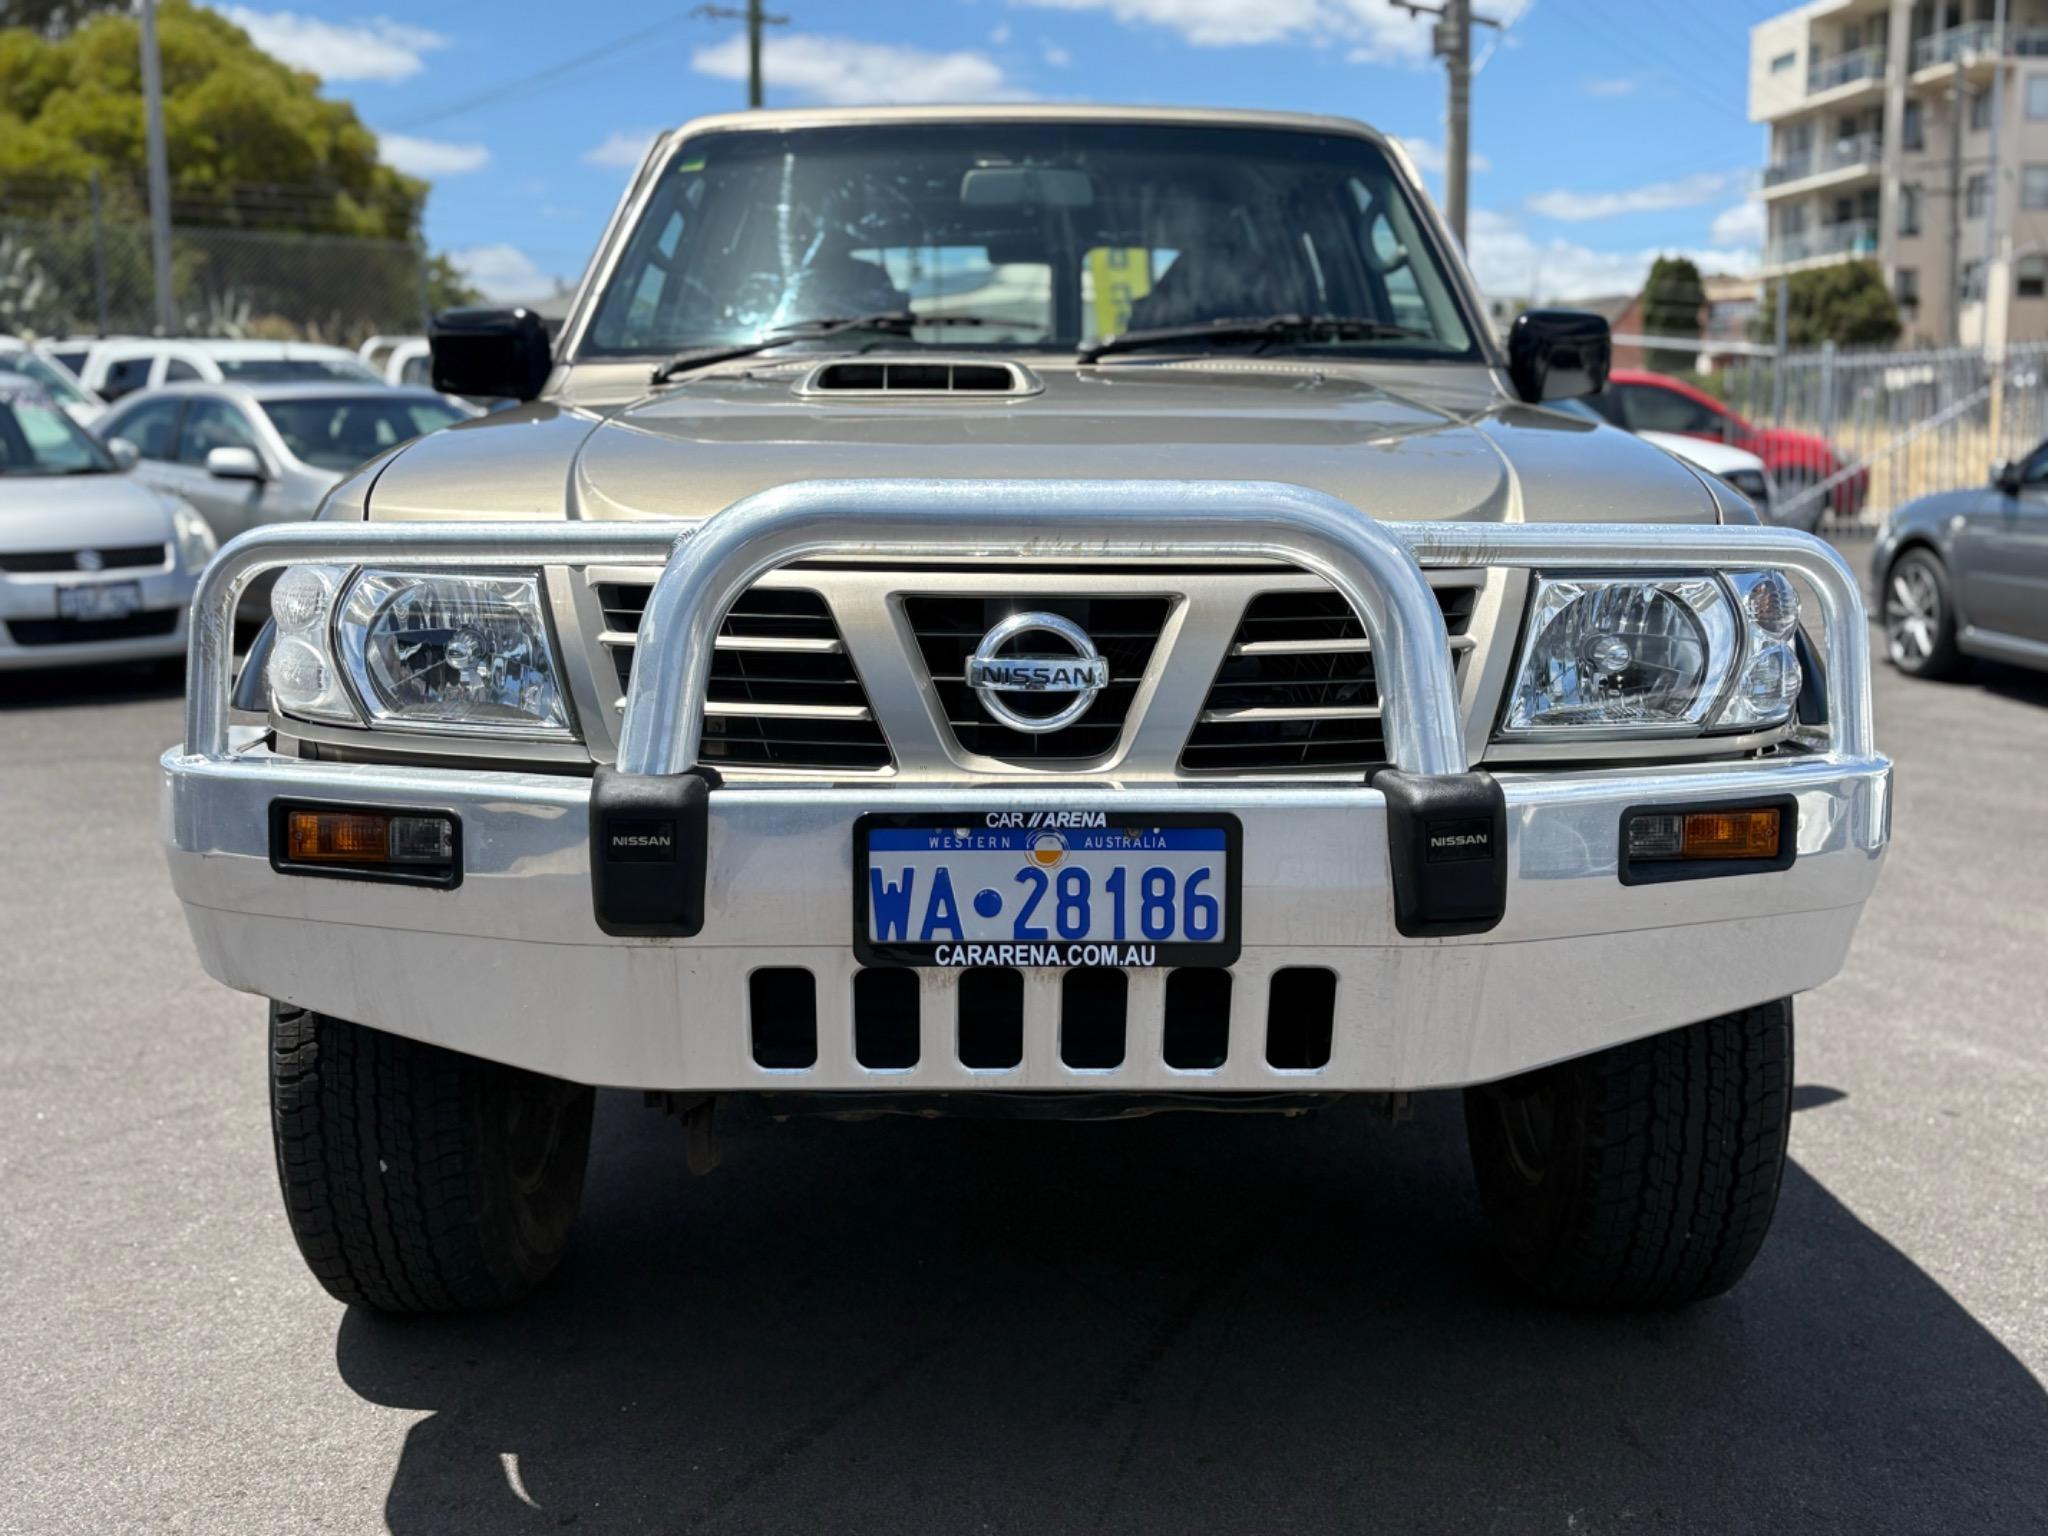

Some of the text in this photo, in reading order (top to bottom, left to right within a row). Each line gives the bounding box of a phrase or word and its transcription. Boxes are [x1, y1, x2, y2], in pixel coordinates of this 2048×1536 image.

[981, 666, 1093, 685] NISSAN
[986, 812, 1024, 828] CAR
[612, 836, 671, 846] NISSAN
[928, 836, 1167, 849] WESTERN AUSTRALIA
[1430, 834, 1488, 848] NISSAN
[935, 945, 1156, 966] CARARENA.COM.AU
